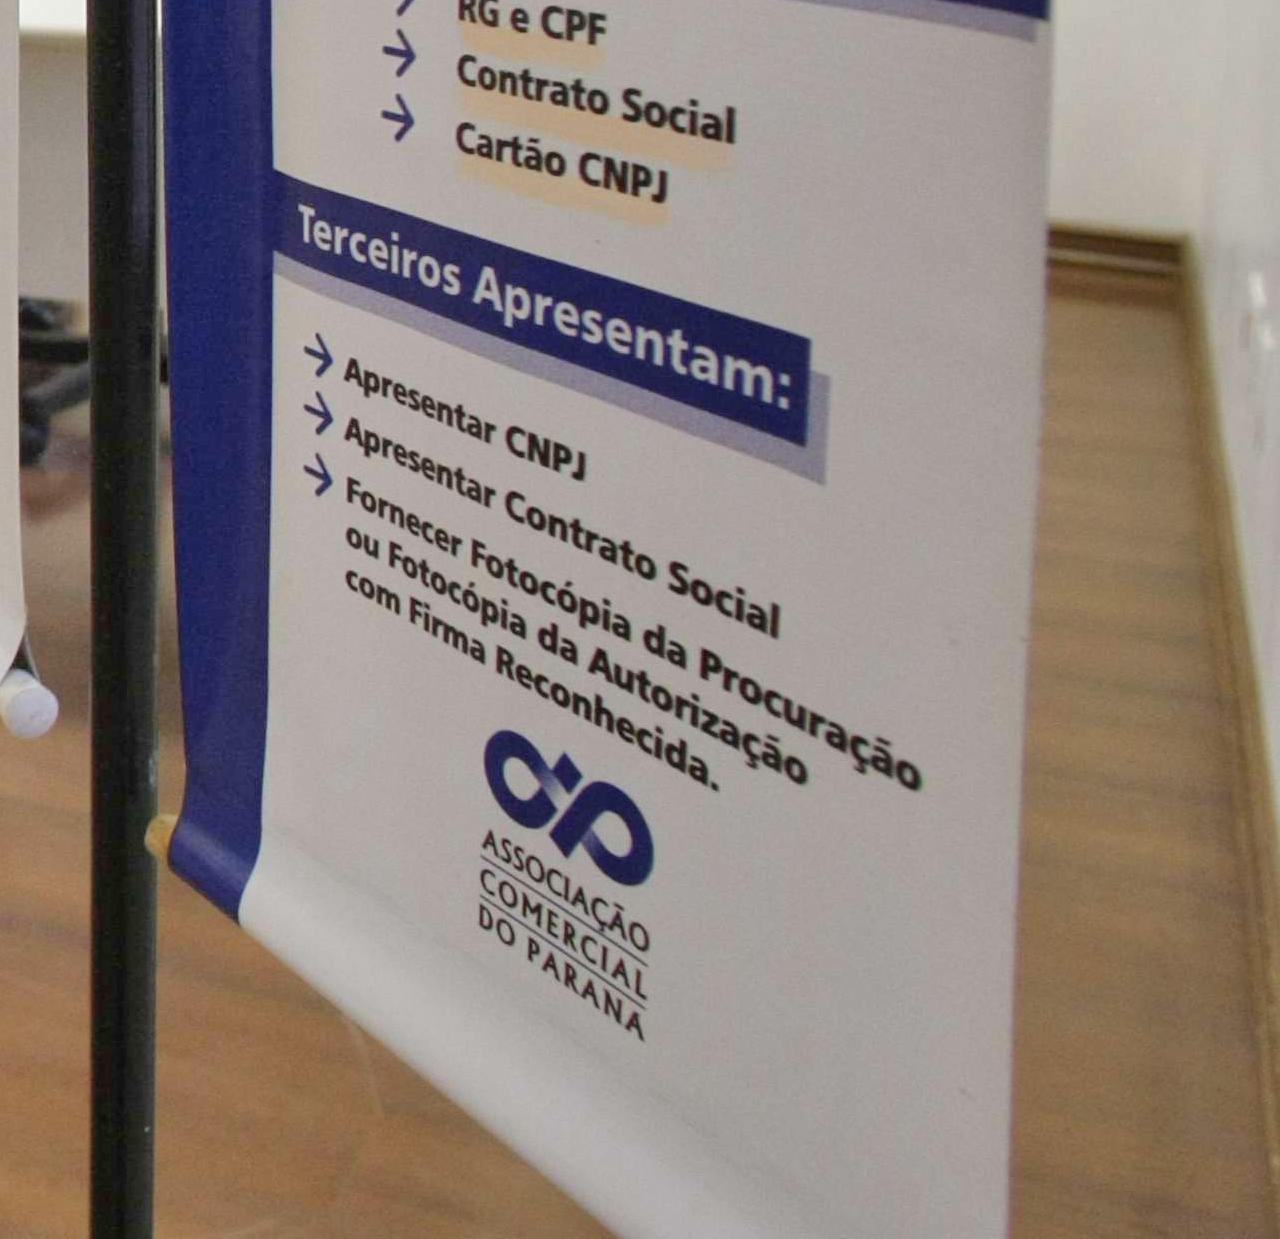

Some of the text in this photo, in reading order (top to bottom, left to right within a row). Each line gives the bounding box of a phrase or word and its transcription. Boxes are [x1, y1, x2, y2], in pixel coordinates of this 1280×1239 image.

[511, 6, 529, 32] e
[541, 5, 606, 45] CPF
[456, 122, 668, 203] Cartão CNPJ
[458, 56, 736, 143] Contrato Social
[299, 204, 790, 409] Terceiros Apresentam:
[344, 358, 586, 481] Apresentar CNPJ
[344, 418, 779, 639] Apresentar Contrato Social
[346, 527, 807, 785] ou Fotocópia da Autorização
[346, 570, 719, 791] com Firma Reconhecida.
[347, 477, 921, 791] Fornecer Fotocópia da Procuração
[479, 904, 515, 945] DO
[480, 869, 647, 1000] COMERCIAL
[482, 829, 650, 951] ASSOCIAÇÃO
